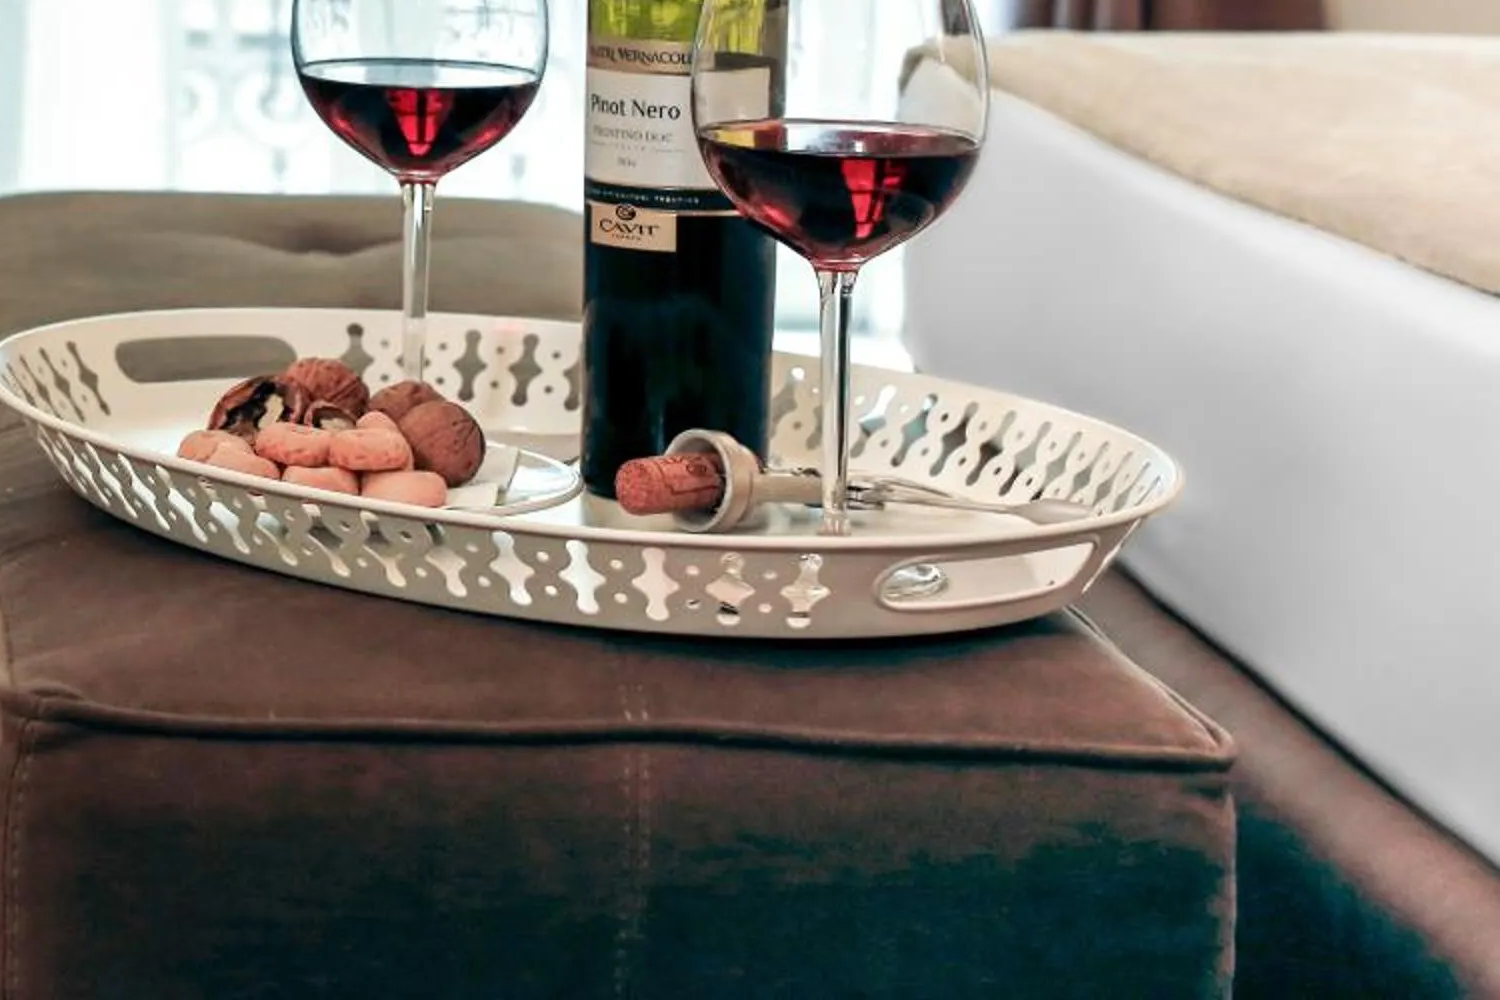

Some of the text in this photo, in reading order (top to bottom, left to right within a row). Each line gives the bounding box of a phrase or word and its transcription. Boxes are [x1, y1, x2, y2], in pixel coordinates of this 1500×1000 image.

[591, 93, 681, 120] Pinot Nero
[599, 217, 660, 236] CAVIT
